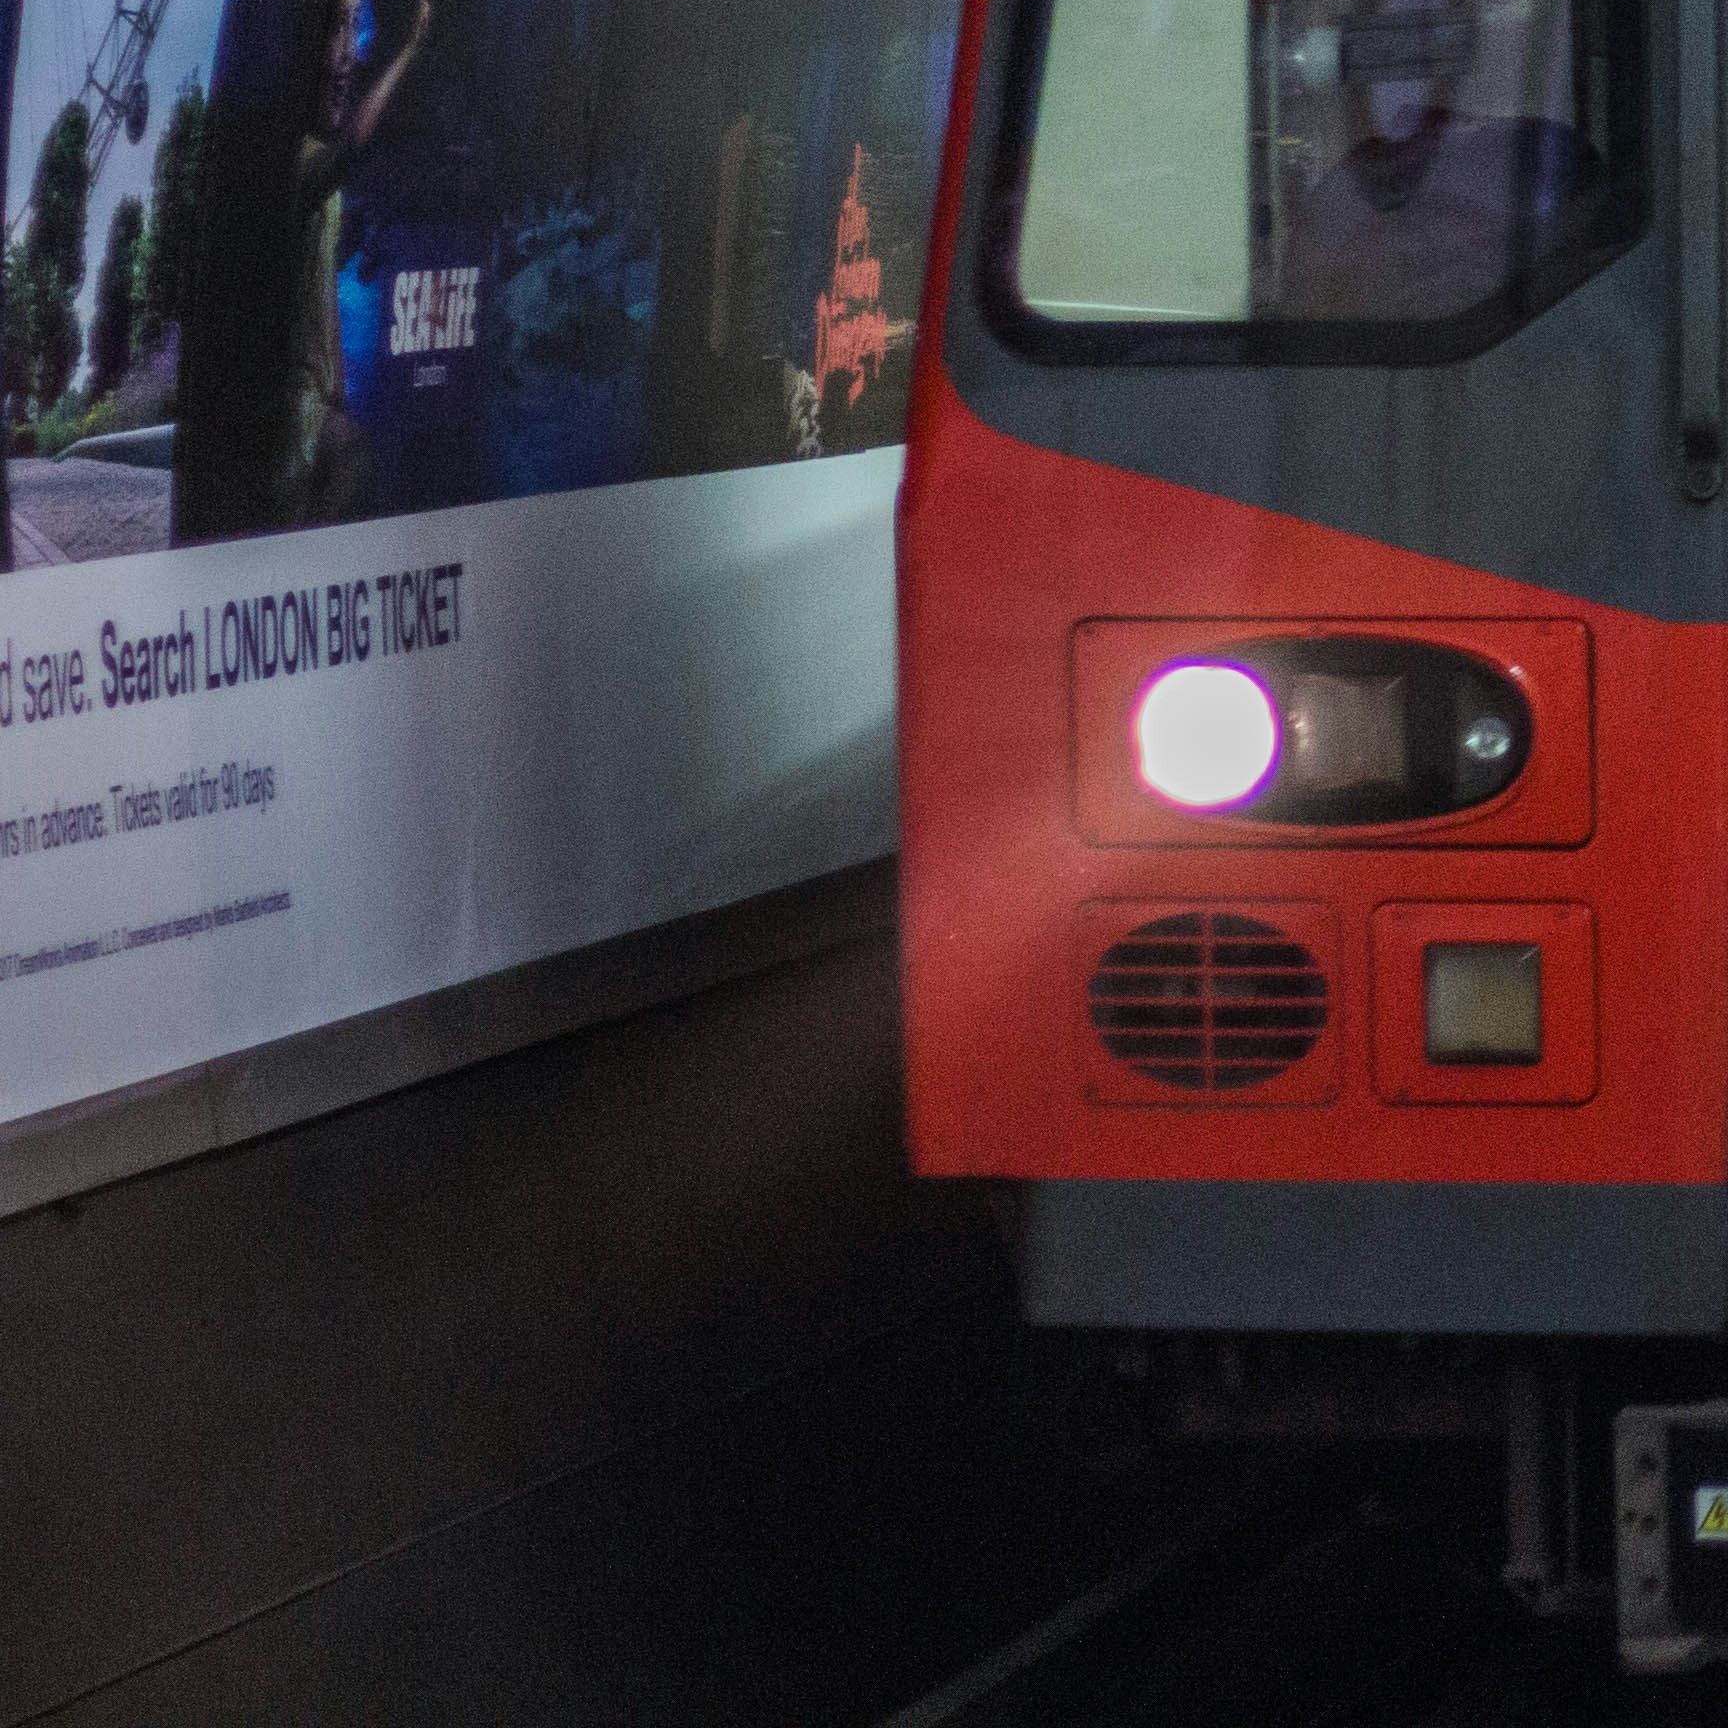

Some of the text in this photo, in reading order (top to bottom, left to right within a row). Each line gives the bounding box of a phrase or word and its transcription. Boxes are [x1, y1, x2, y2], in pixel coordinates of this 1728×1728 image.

[390, 270, 432, 356] SEA
[22, 650, 92, 722] save.
[101, 610, 195, 708] Search
[204, 588, 318, 689] LONDON
[327, 579, 370, 666] BIG
[376, 563, 463, 655] TICKET
[109, 783, 162, 833] Tickets
[164, 772, 198, 821] valid
[221, 762, 239, 810] 90
[243, 759, 275, 815] days
